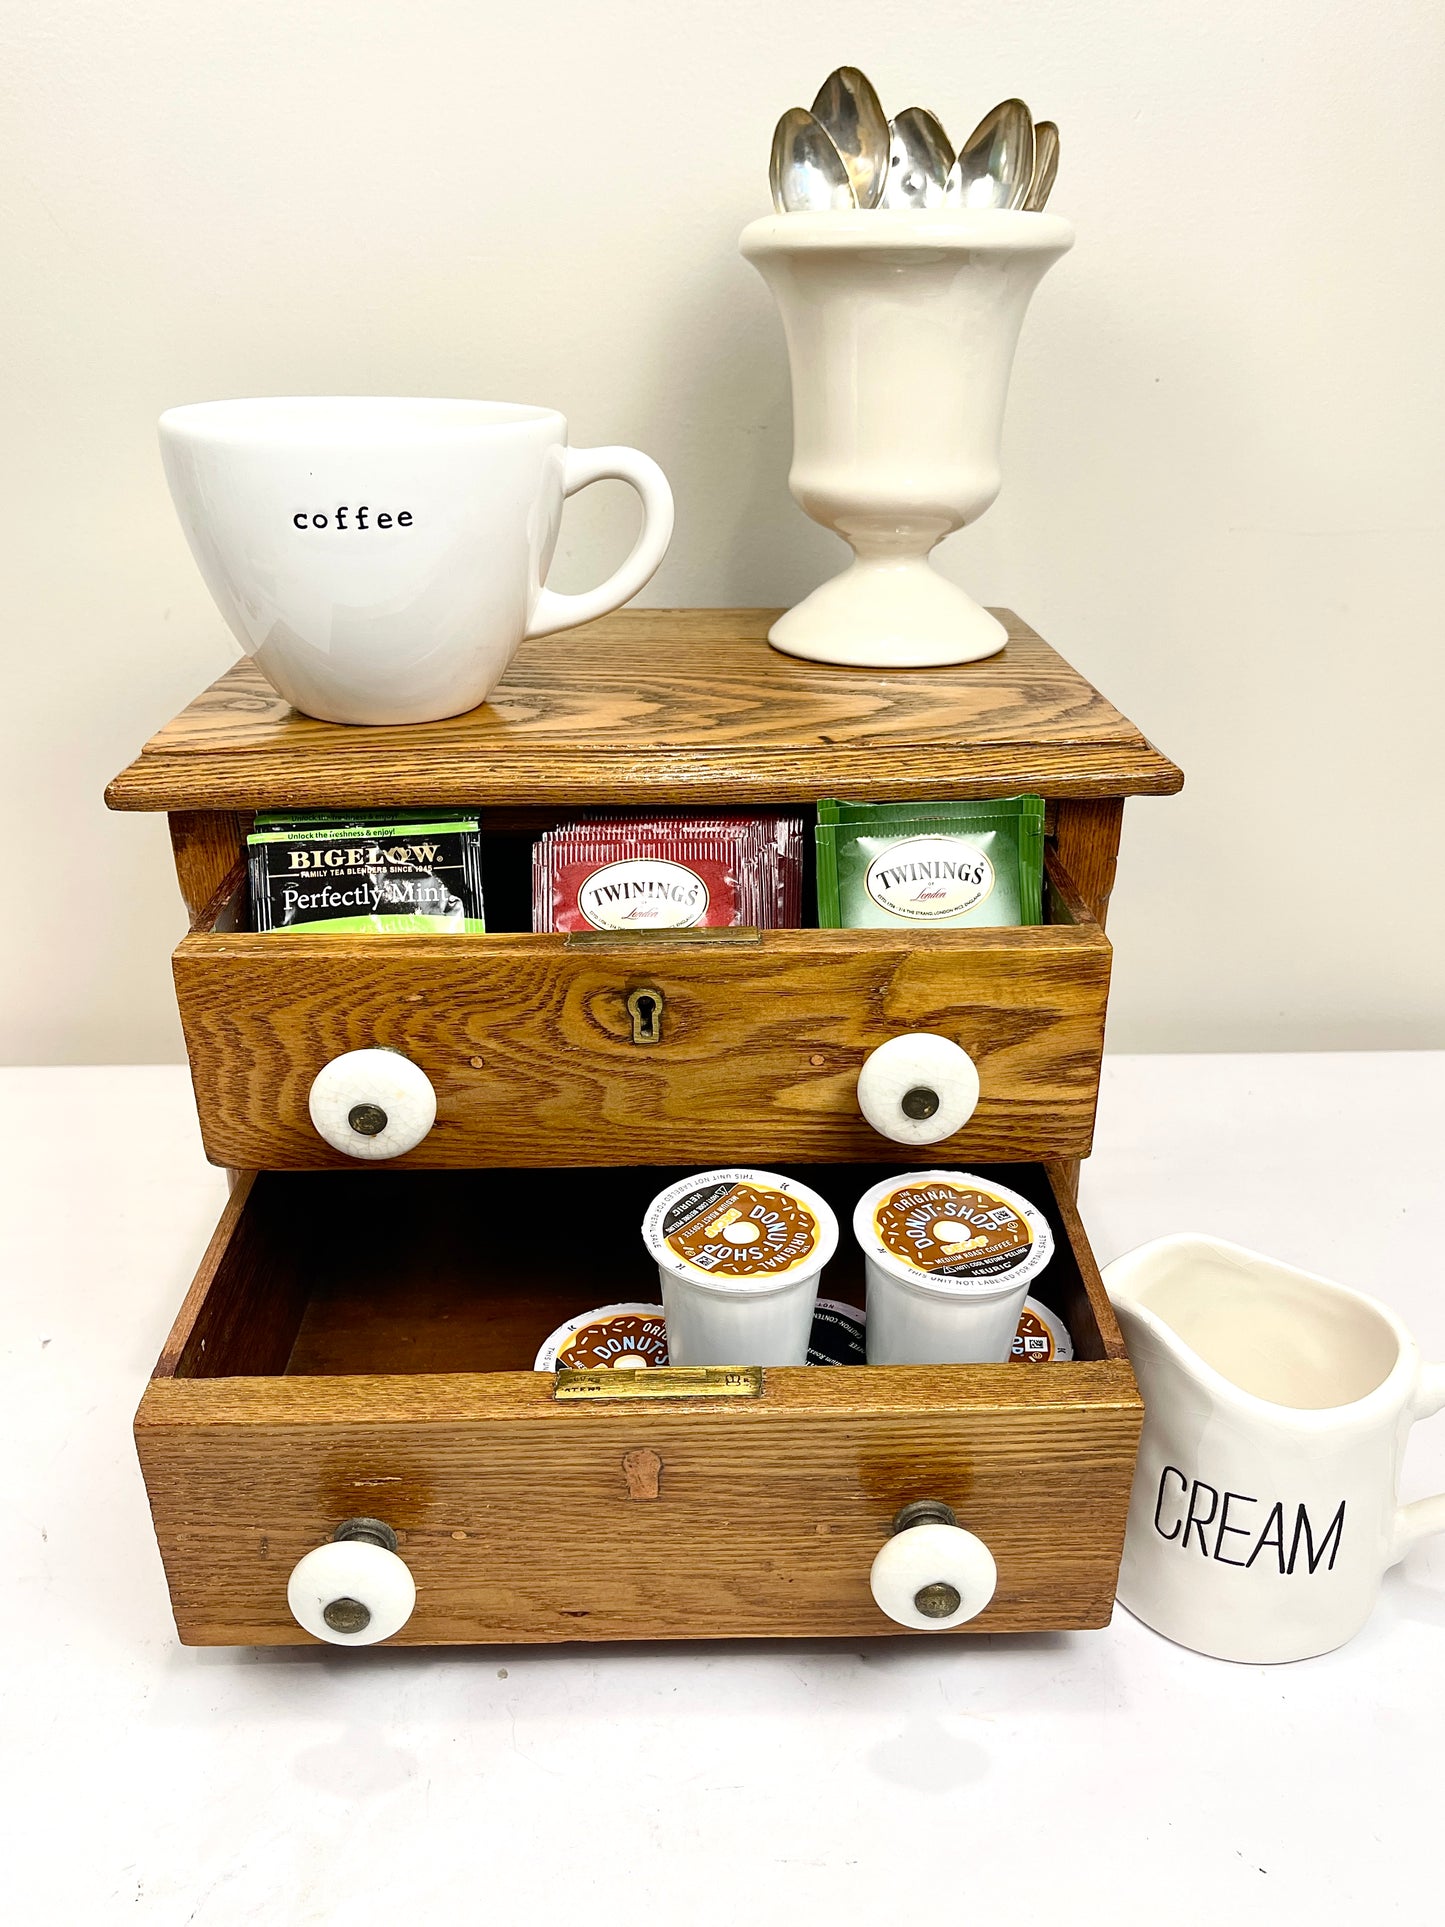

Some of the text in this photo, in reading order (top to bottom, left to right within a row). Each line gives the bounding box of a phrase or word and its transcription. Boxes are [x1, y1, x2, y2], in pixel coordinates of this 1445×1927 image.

[293, 506, 413, 530] coffee
[288, 832, 314, 840] Unlock
[315, 831, 327, 839] the
[329, 830, 364, 838] freshness
[373, 828, 396, 837] enjoy!
[300, 864, 433, 878] FAMILY TEA BLENDERS SINCE 1945
[875, 861, 985, 890] TWININGS
[283, 882, 449, 911] Perfectly Mint
[589, 881, 698, 906] TWININGS
[910, 887, 947, 902] London
[694, 1177, 710, 1186] NOT
[712, 1173, 732, 1181] UNIT
[671, 1192, 703, 1217] KEURIG
[893, 1189, 957, 1212] ORIGINAL
[897, 1190, 911, 1199] THE
[682, 1195, 740, 1238] MEDIUM ROAST COFFEE
[905, 1202, 998, 1250] DONUT SHOP
[703, 1204, 788, 1262] DONUT SHOP
[940, 1235, 990, 1256] DECAF
[757, 1232, 809, 1270] ORIGINAL
[907, 1268, 927, 1279] THIS
[930, 1276, 952, 1284] UNIT
[978, 1273, 1015, 1286] LABELED
[1016, 1265, 1029, 1277] FOR
[1027, 1249, 1045, 1268] RETAIL
[1038, 1234, 1047, 1249] SALE
[934, 1240, 1013, 1265] MEDIUM ROAST COFFEE
[954, 1247, 1028, 1272] HOT! COOL BEFORE PEELING
[971, 1261, 1012, 1276] KEURIG
[814, 1312, 839, 1324] CONTEN
[642, 1322, 668, 1341] ORIG
[592, 1335, 665, 1360] DONUT
[1154, 1465, 1347, 1575] CREAM
